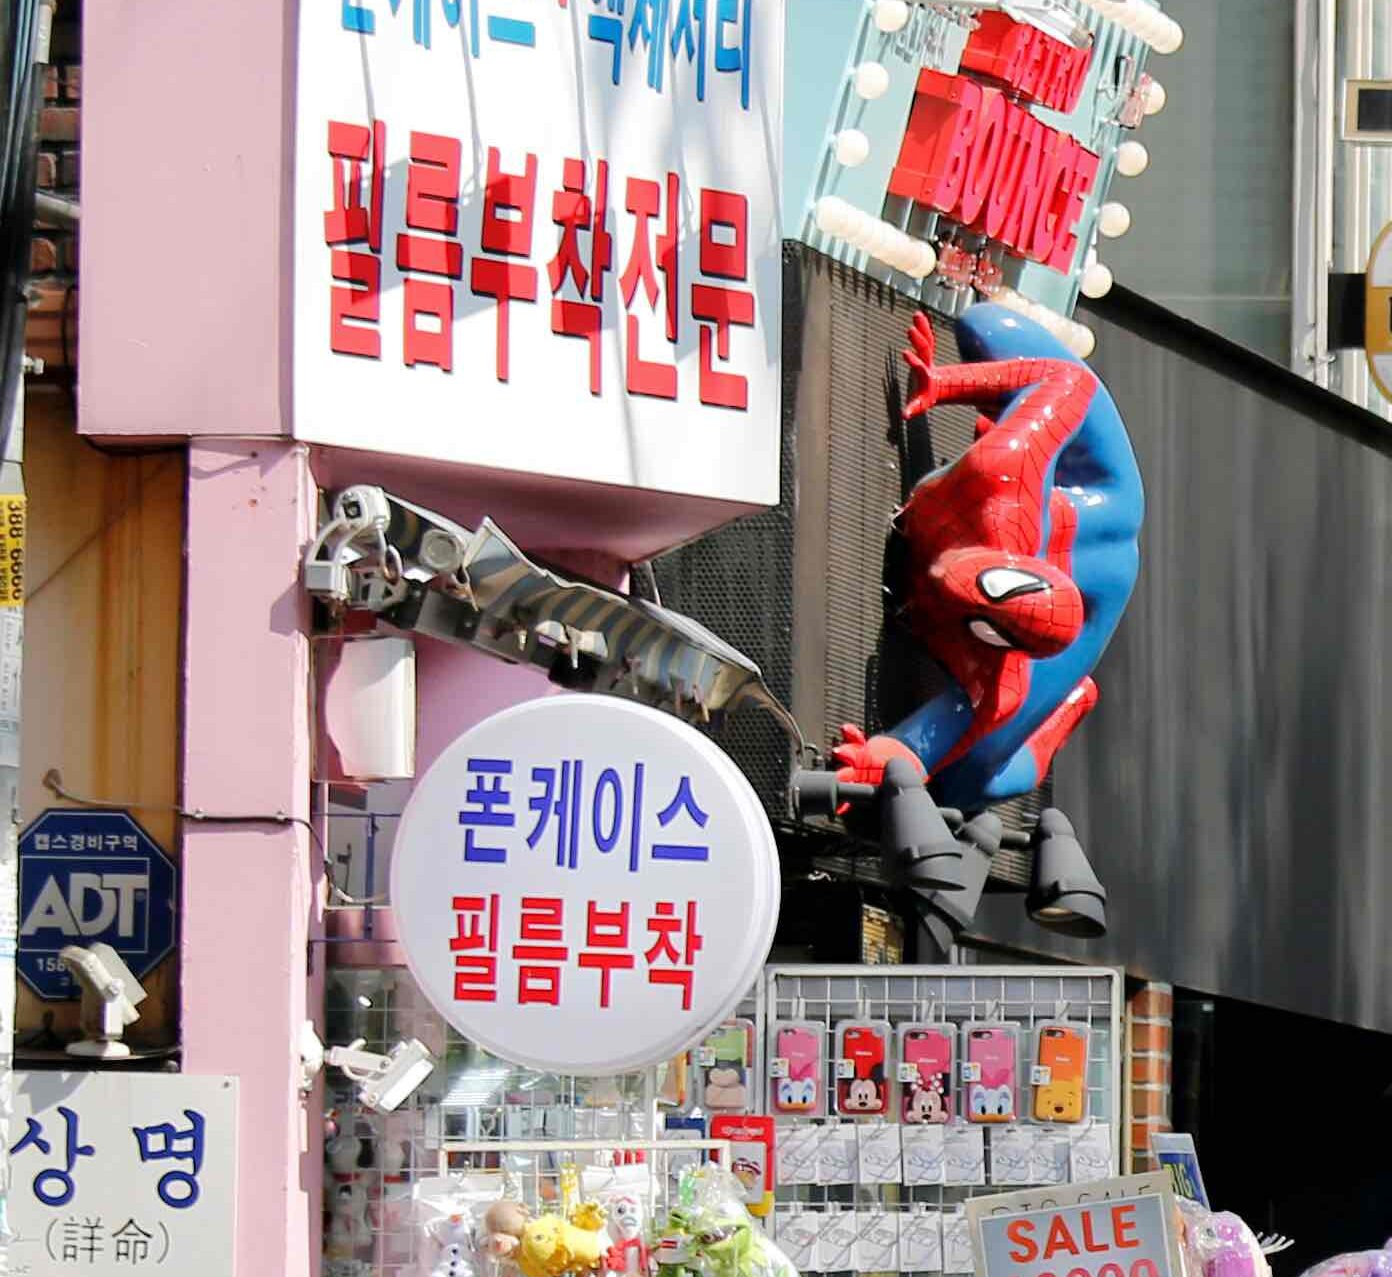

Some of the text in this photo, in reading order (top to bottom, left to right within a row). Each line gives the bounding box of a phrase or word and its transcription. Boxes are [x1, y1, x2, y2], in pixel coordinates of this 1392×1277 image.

[934, 75, 1100, 277] BOUNCE
[323, 118, 756, 411] 필름부착전문
[457, 757, 710, 872] 폰케이스
[20, 872, 149, 937] ADT
[448, 893, 703, 1011] 필름부착
[1006, 1203, 1141, 1264] SALE
